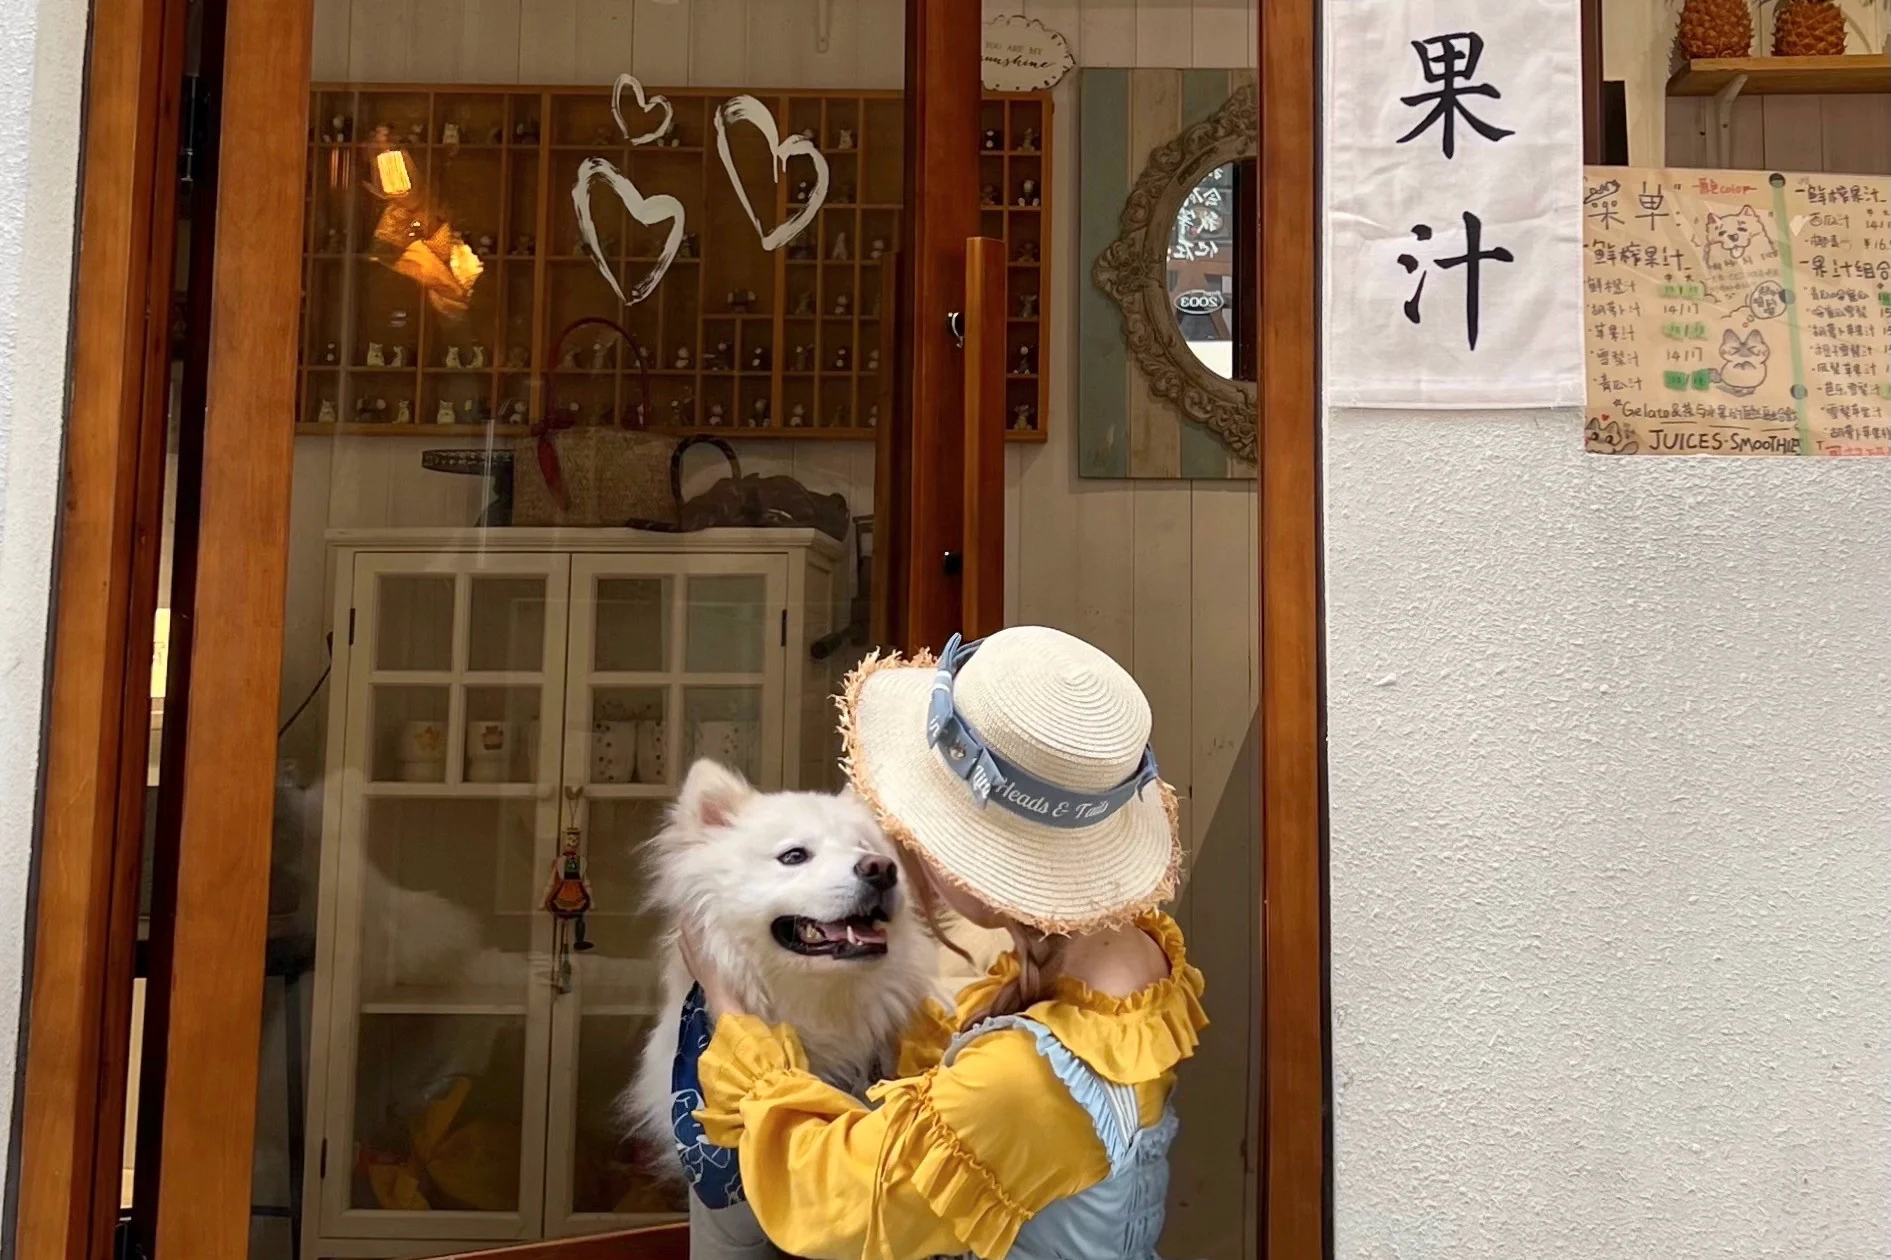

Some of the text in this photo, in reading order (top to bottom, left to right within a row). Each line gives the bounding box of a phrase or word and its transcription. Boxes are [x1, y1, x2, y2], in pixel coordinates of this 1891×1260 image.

[1007, 44, 1024, 52] ARE
[1029, 47, 1043, 55] MY
[981, 55, 1056, 69] unshine
[1396, 32, 1515, 352] 果汁
[1663, 303, 1699, 316] 14/17
[1667, 347, 1702, 361] 14/17
[995, 777, 1049, 815] Heads
[1052, 801, 1070, 818] &
[1075, 800, 1109, 820] Tails
